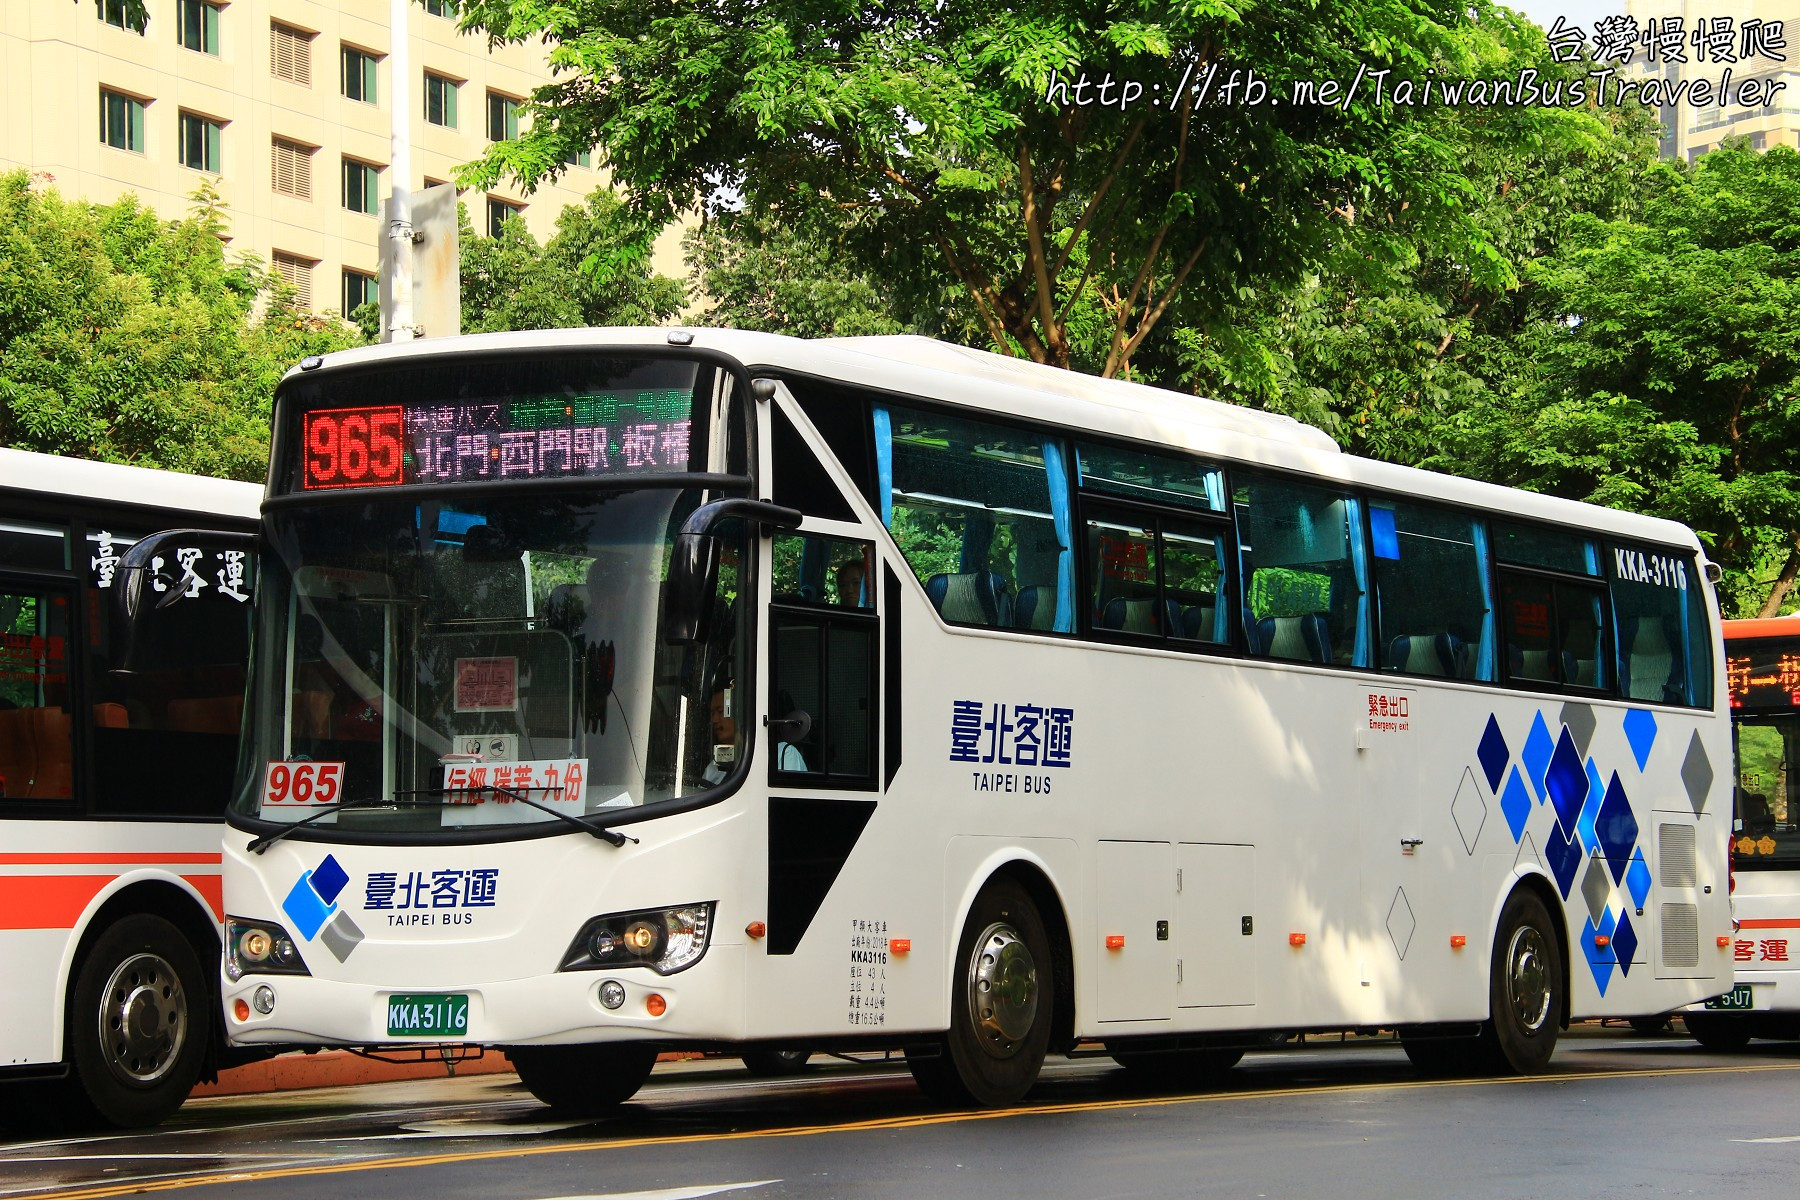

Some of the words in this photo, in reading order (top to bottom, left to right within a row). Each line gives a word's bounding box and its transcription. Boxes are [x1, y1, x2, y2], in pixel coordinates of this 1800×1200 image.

[310, 413, 400, 480] 965
[1614, 547, 1687, 591] KKA-3116
[1368, 694, 1409, 717] 緊急出口
[949, 700, 1074, 768] 臺北客運
[1369, 719, 1398, 733] Emergency
[1399, 720, 1409, 731] exit
[268, 765, 339, 803] 965
[972, 772, 1018, 793] TAIPEI
[1024, 775, 1052, 795] BUS
[363, 868, 500, 910] 臺北客運
[387, 914, 435, 926] TAIPEI
[442, 913, 473, 925] BUS
[851, 950, 887, 965] KKA3116
[1734, 939, 1789, 962] 客運
[1706, 990, 1751, 1006] 5-U7
